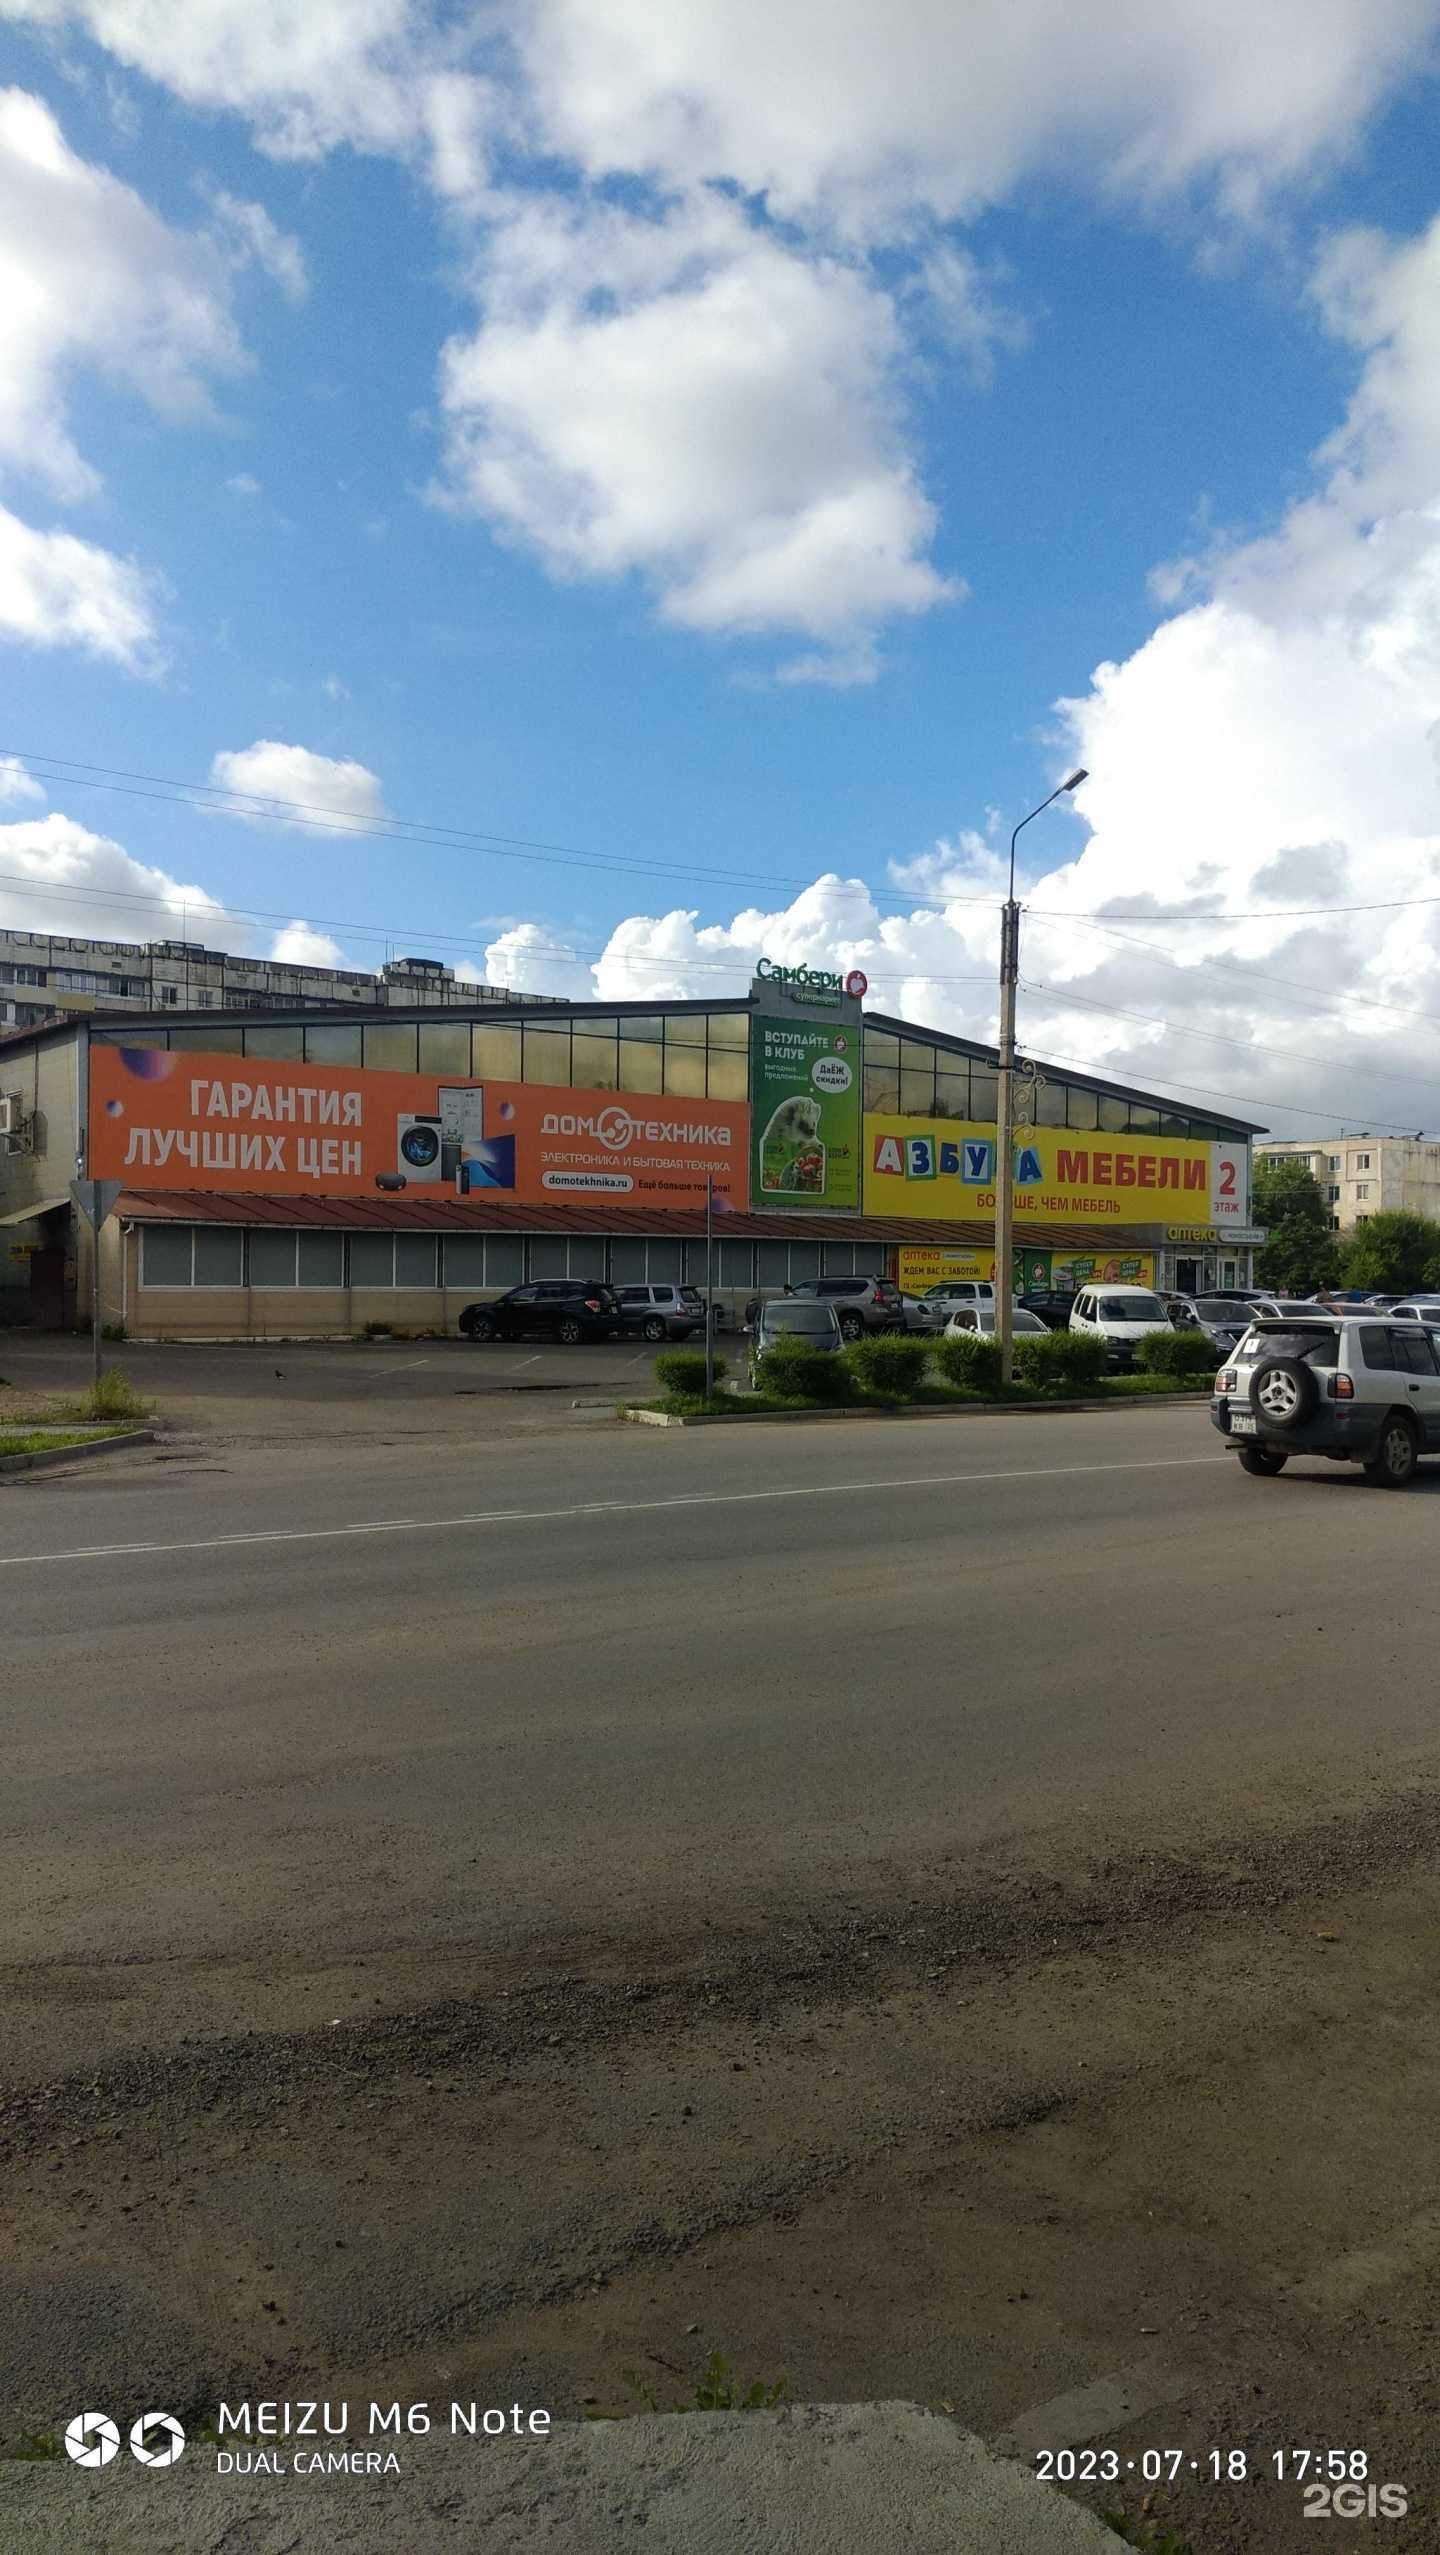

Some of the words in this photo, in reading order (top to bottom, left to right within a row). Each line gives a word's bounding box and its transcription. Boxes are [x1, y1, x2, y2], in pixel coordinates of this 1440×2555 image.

[756, 957, 843, 993] Самбери
[764, 1031, 829, 1048] ВСТУПАЙТЕ
[764, 1045, 772, 1057] В
[775, 1047, 805, 1060] КЛУБ
[816, 1075, 848, 1086] скидки!
[190, 1079, 362, 1127] ГАРАНТИЯ
[124, 1127, 287, 1173] ЛУЧШИХ
[297, 1137, 362, 1179] ЦЕН
[540, 1151, 620, 1165] ЭЛЕКТРОНИКА
[623, 1157, 631, 1167] И
[633, 1158, 684, 1169] БЫТОВАЯ
[686, 1161, 731, 1172] ТЕХНИКА
[874, 1136, 1043, 1184] АЗБУА
[1056, 1148, 1207, 1191] МЕБЕЛИ
[548, 1175, 629, 1188] domotekhnika.ru
[658, 1180, 692, 1191] больше
[693, 1184, 731, 1193] товров!
[1219, 1161, 1236, 1196] 2
[976, 1194, 1038, 1210] БОШЕ,
[1041, 1197, 1068, 1210] ЧЕМ
[1071, 1198, 1121, 1213] МЕБЕЛЬ
[1213, 1201, 1239, 1213] этаж
[1168, 1226, 1217, 1241] аптека
[903, 1251, 941, 1261] аптека
[927, 1266, 940, 1275] ВАС
